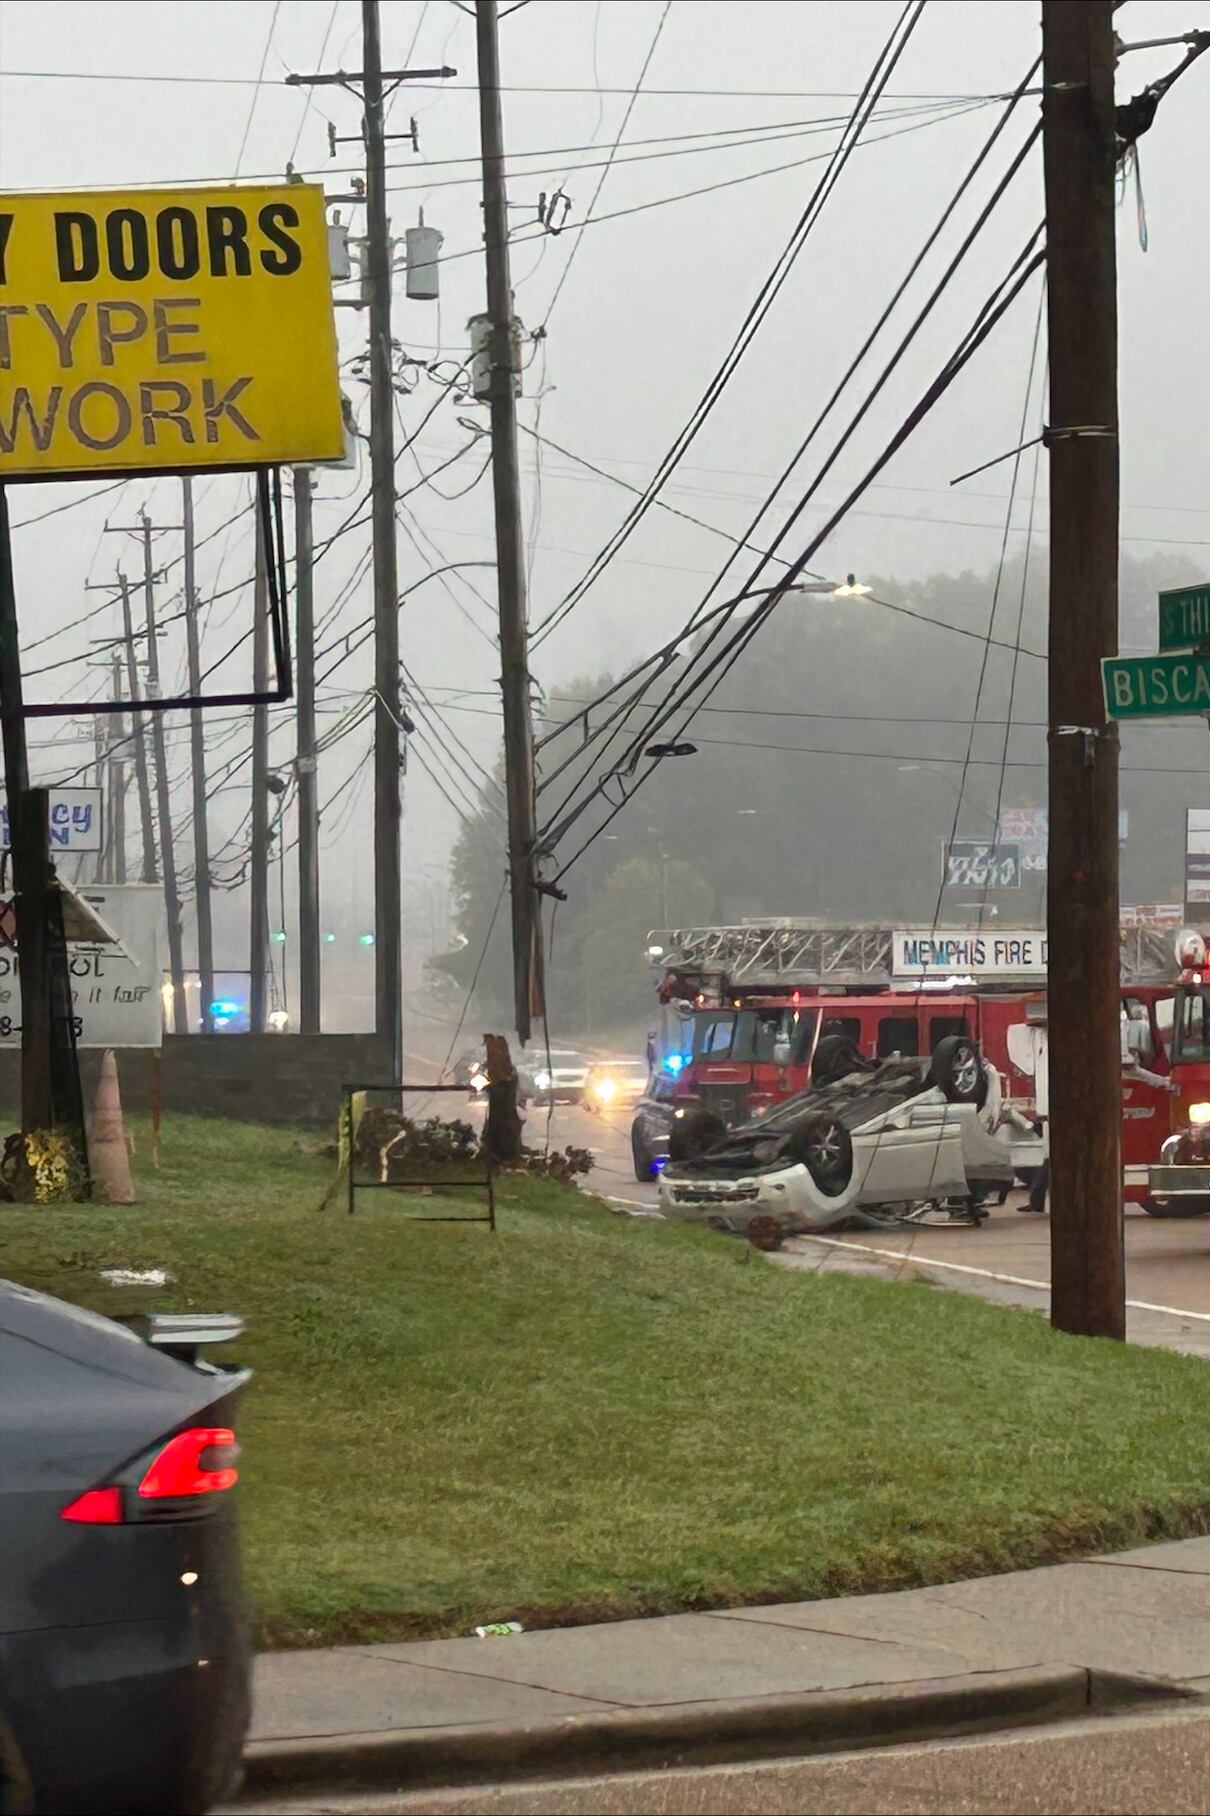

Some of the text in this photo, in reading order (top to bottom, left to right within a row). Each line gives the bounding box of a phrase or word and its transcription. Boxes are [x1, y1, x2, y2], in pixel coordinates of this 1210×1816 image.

[54, 203, 303, 282] DOORS
[0, 298, 207, 369] TYPE
[0, 376, 263, 453] WORK
[904, 940, 986, 966] MEMPHIS
[994, 940, 1032, 965] FIRE
